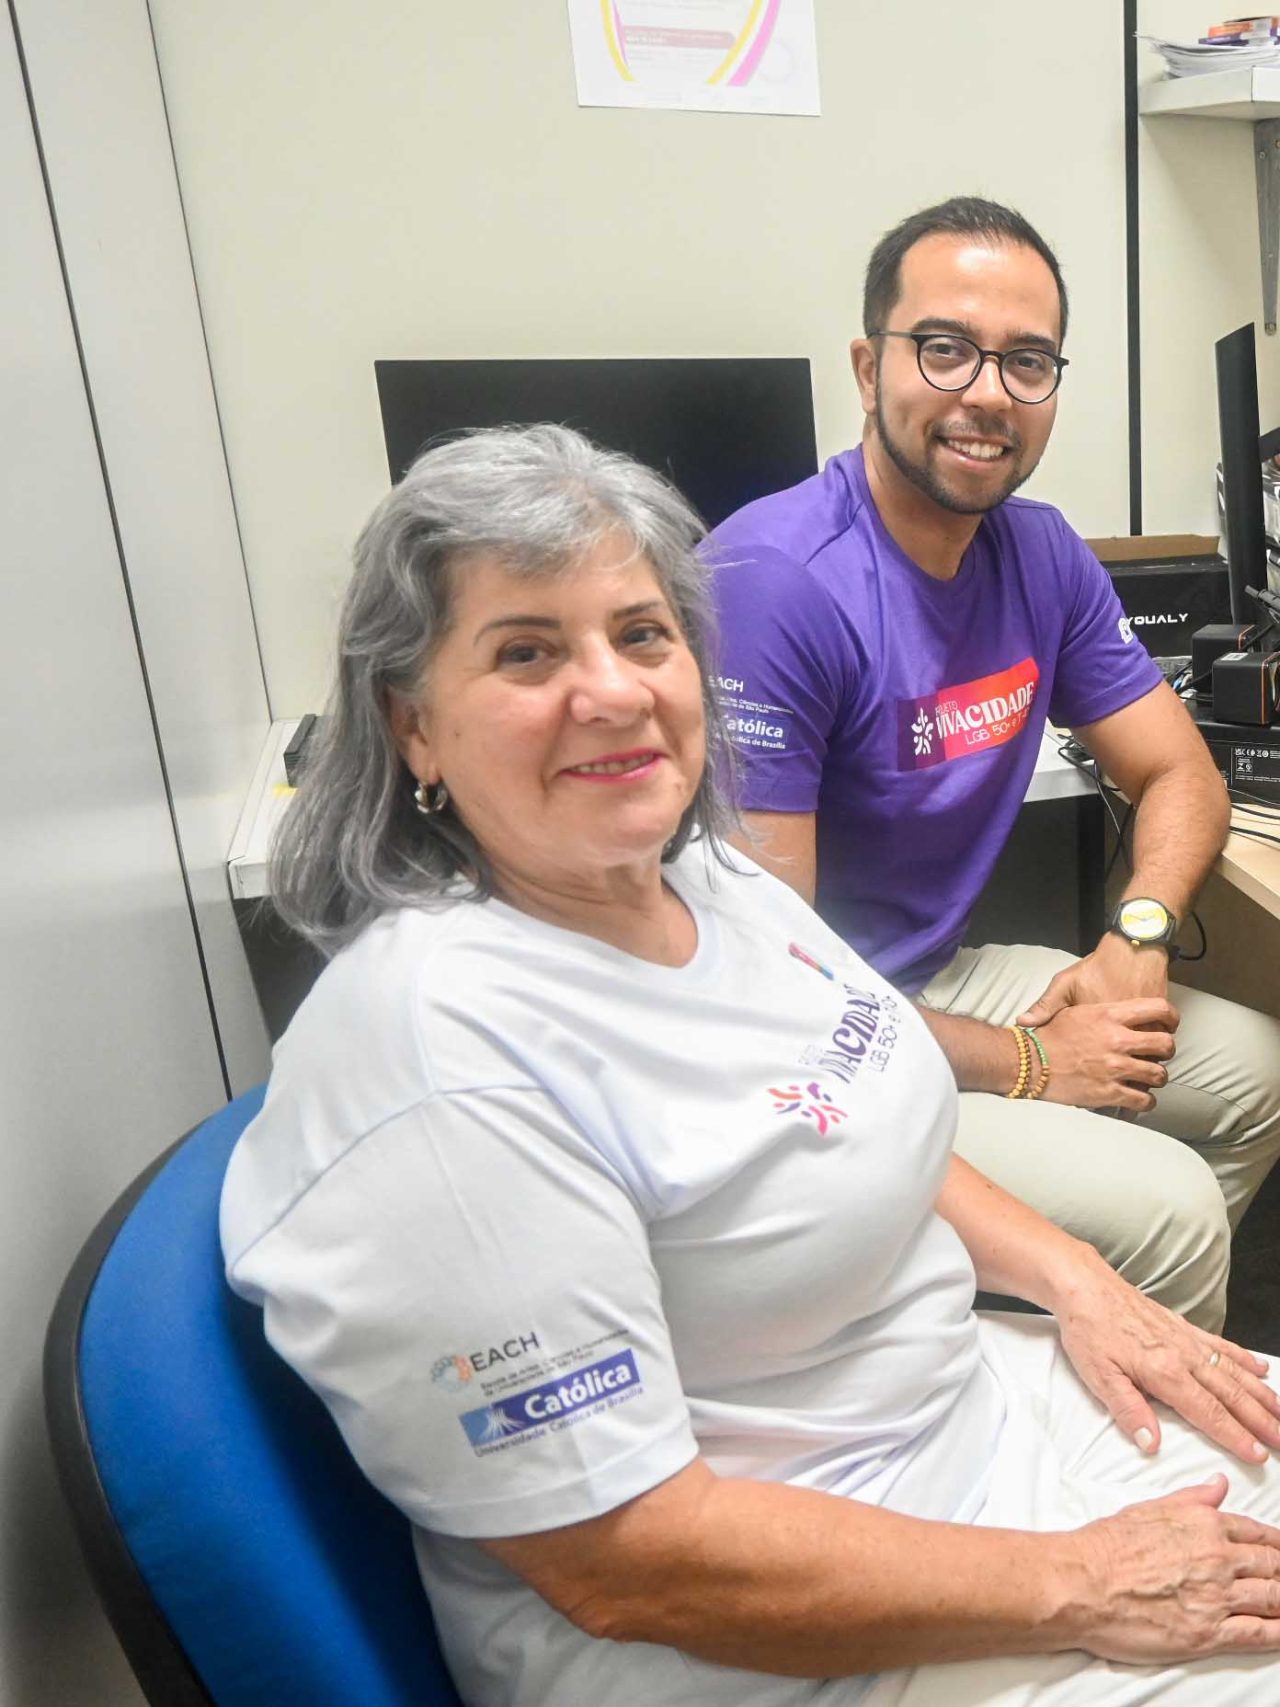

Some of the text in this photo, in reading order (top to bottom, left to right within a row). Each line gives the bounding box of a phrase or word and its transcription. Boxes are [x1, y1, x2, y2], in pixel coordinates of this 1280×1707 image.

[724, 714, 784, 738] atólica
[936, 682, 1034, 739] VIVACIDADE
[965, 729, 991, 745] LGB
[470, 1331, 540, 1372] EACH
[524, 1363, 632, 1419] Católica
[474, 1429, 546, 1458] Universidade
[550, 1411, 591, 1433] Católica
[593, 1404, 605, 1415] de
